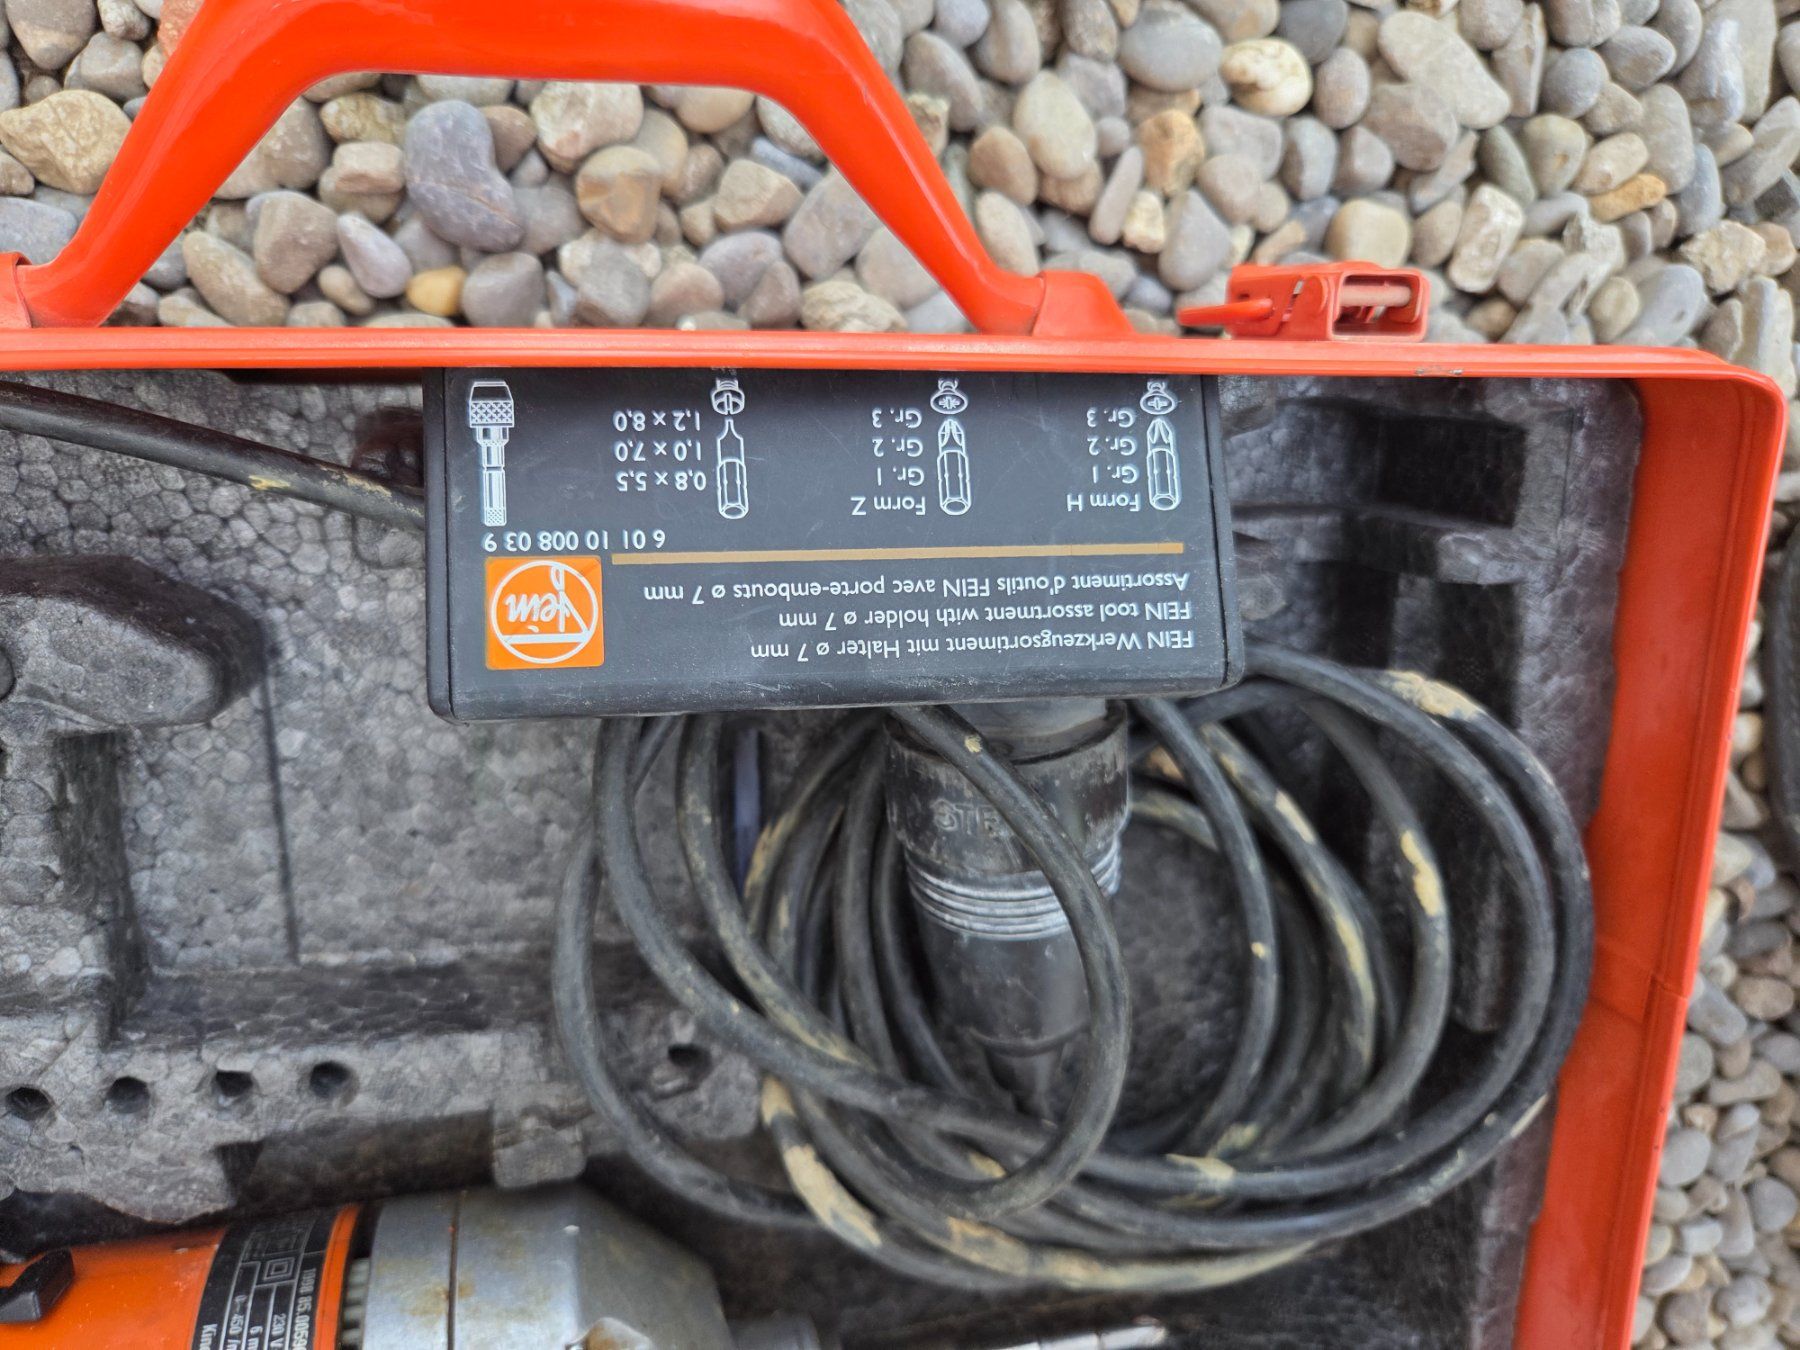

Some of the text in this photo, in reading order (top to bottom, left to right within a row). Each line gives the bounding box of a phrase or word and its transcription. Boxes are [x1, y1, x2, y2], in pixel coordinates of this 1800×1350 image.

[614, 410, 645, 431] 8,0
[674, 410, 700, 431] 1,2
[871, 408, 923, 428] Gr. 3
[1086, 408, 1136, 426] Gr. 3
[615, 442, 645, 462] 7,0
[674, 441, 701, 461] 1,0
[873, 437, 924, 457] Gr. 2
[1088, 436, 1137, 455] Gr. 2
[616, 471, 647, 491] 5,5
[676, 471, 706, 491] 0,8
[877, 466, 925, 486] Gr. 1
[1093, 465, 1139, 484] Gr. 1
[851, 496, 926, 516] Form Z
[1067, 493, 1141, 512] Form H
[483, 529, 666, 552] 6 01 10 008 03 9
[734, 576, 884, 600] porte-embouts
[892, 580, 935, 593] avec
[943, 578, 989, 597] FEIN
[998, 576, 1065, 596] d'outils
[1072, 573, 1190, 591] Assortiment
[644, 587, 684, 600] mm
[692, 586, 704, 604] 7
[779, 614, 816, 626] mm
[865, 610, 929, 629] holder
[937, 608, 978, 627] with
[985, 606, 1093, 623] assortment
[1100, 603, 1138, 622] tool
[1144, 603, 1192, 619] FEIN
[825, 613, 837, 631] 7
[906, 639, 940, 656] mit
[947, 630, 1141, 653] Werkzeugsortiment
[1148, 631, 1194, 648] FEIN
[751, 645, 790, 658] mm
[797, 644, 809, 662] 7
[837, 639, 900, 660] Halter
[249, 1325, 263, 1335] 6
[271, 1313, 287, 1336] 230
